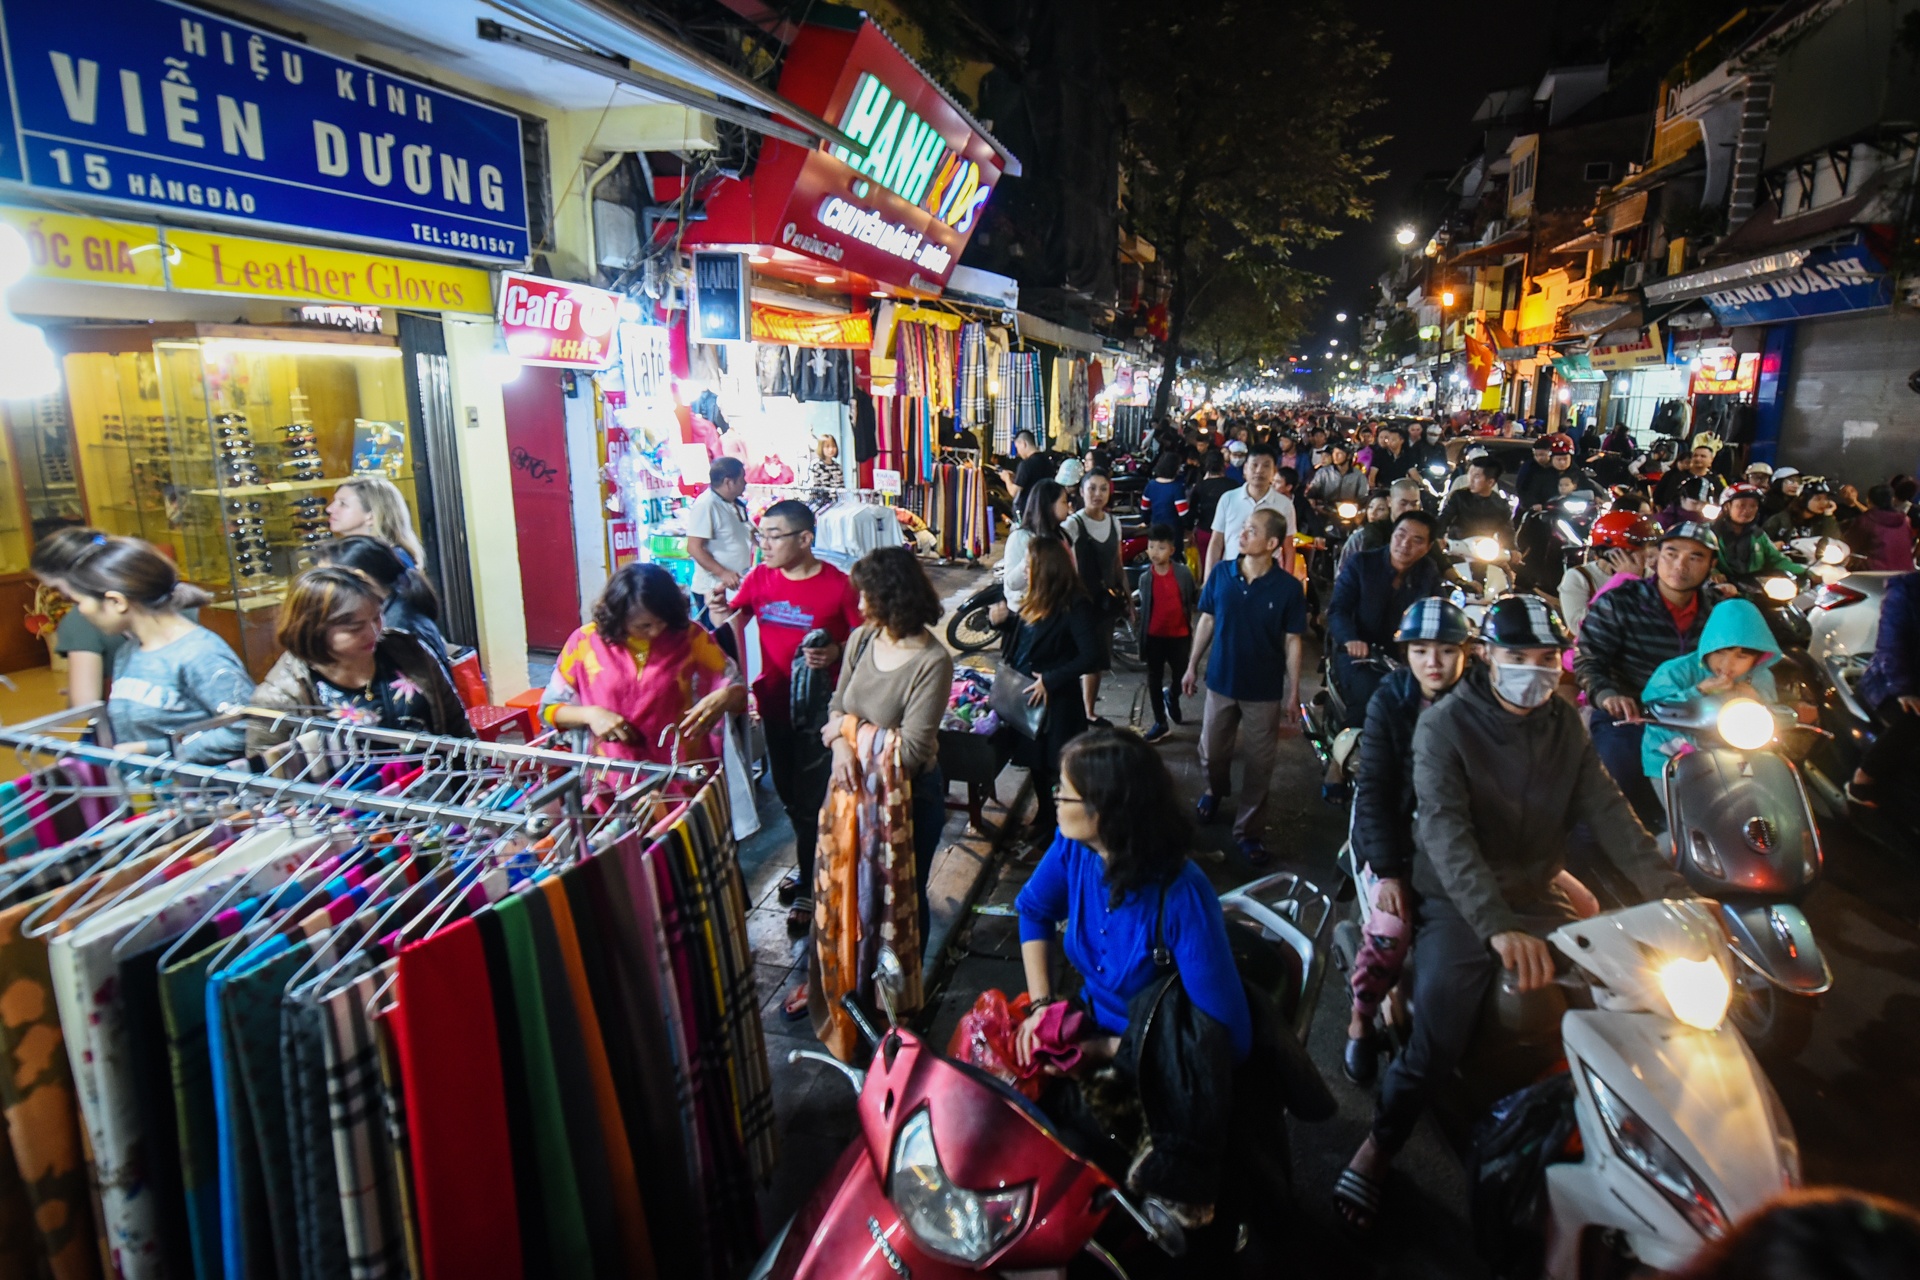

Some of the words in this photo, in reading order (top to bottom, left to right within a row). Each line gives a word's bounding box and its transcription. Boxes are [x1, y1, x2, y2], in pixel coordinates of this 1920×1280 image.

[180, 17, 304, 85] HIỆU
[335, 68, 434, 124] KÍNH
[48, 50, 265, 162] VIỄN
[312, 119, 505, 213] DƯƠNG
[49, 148, 113, 190] 15
[83, 236, 136, 275] GIA
[208, 243, 356, 297] Leather
[366, 261, 464, 306] Gloves
